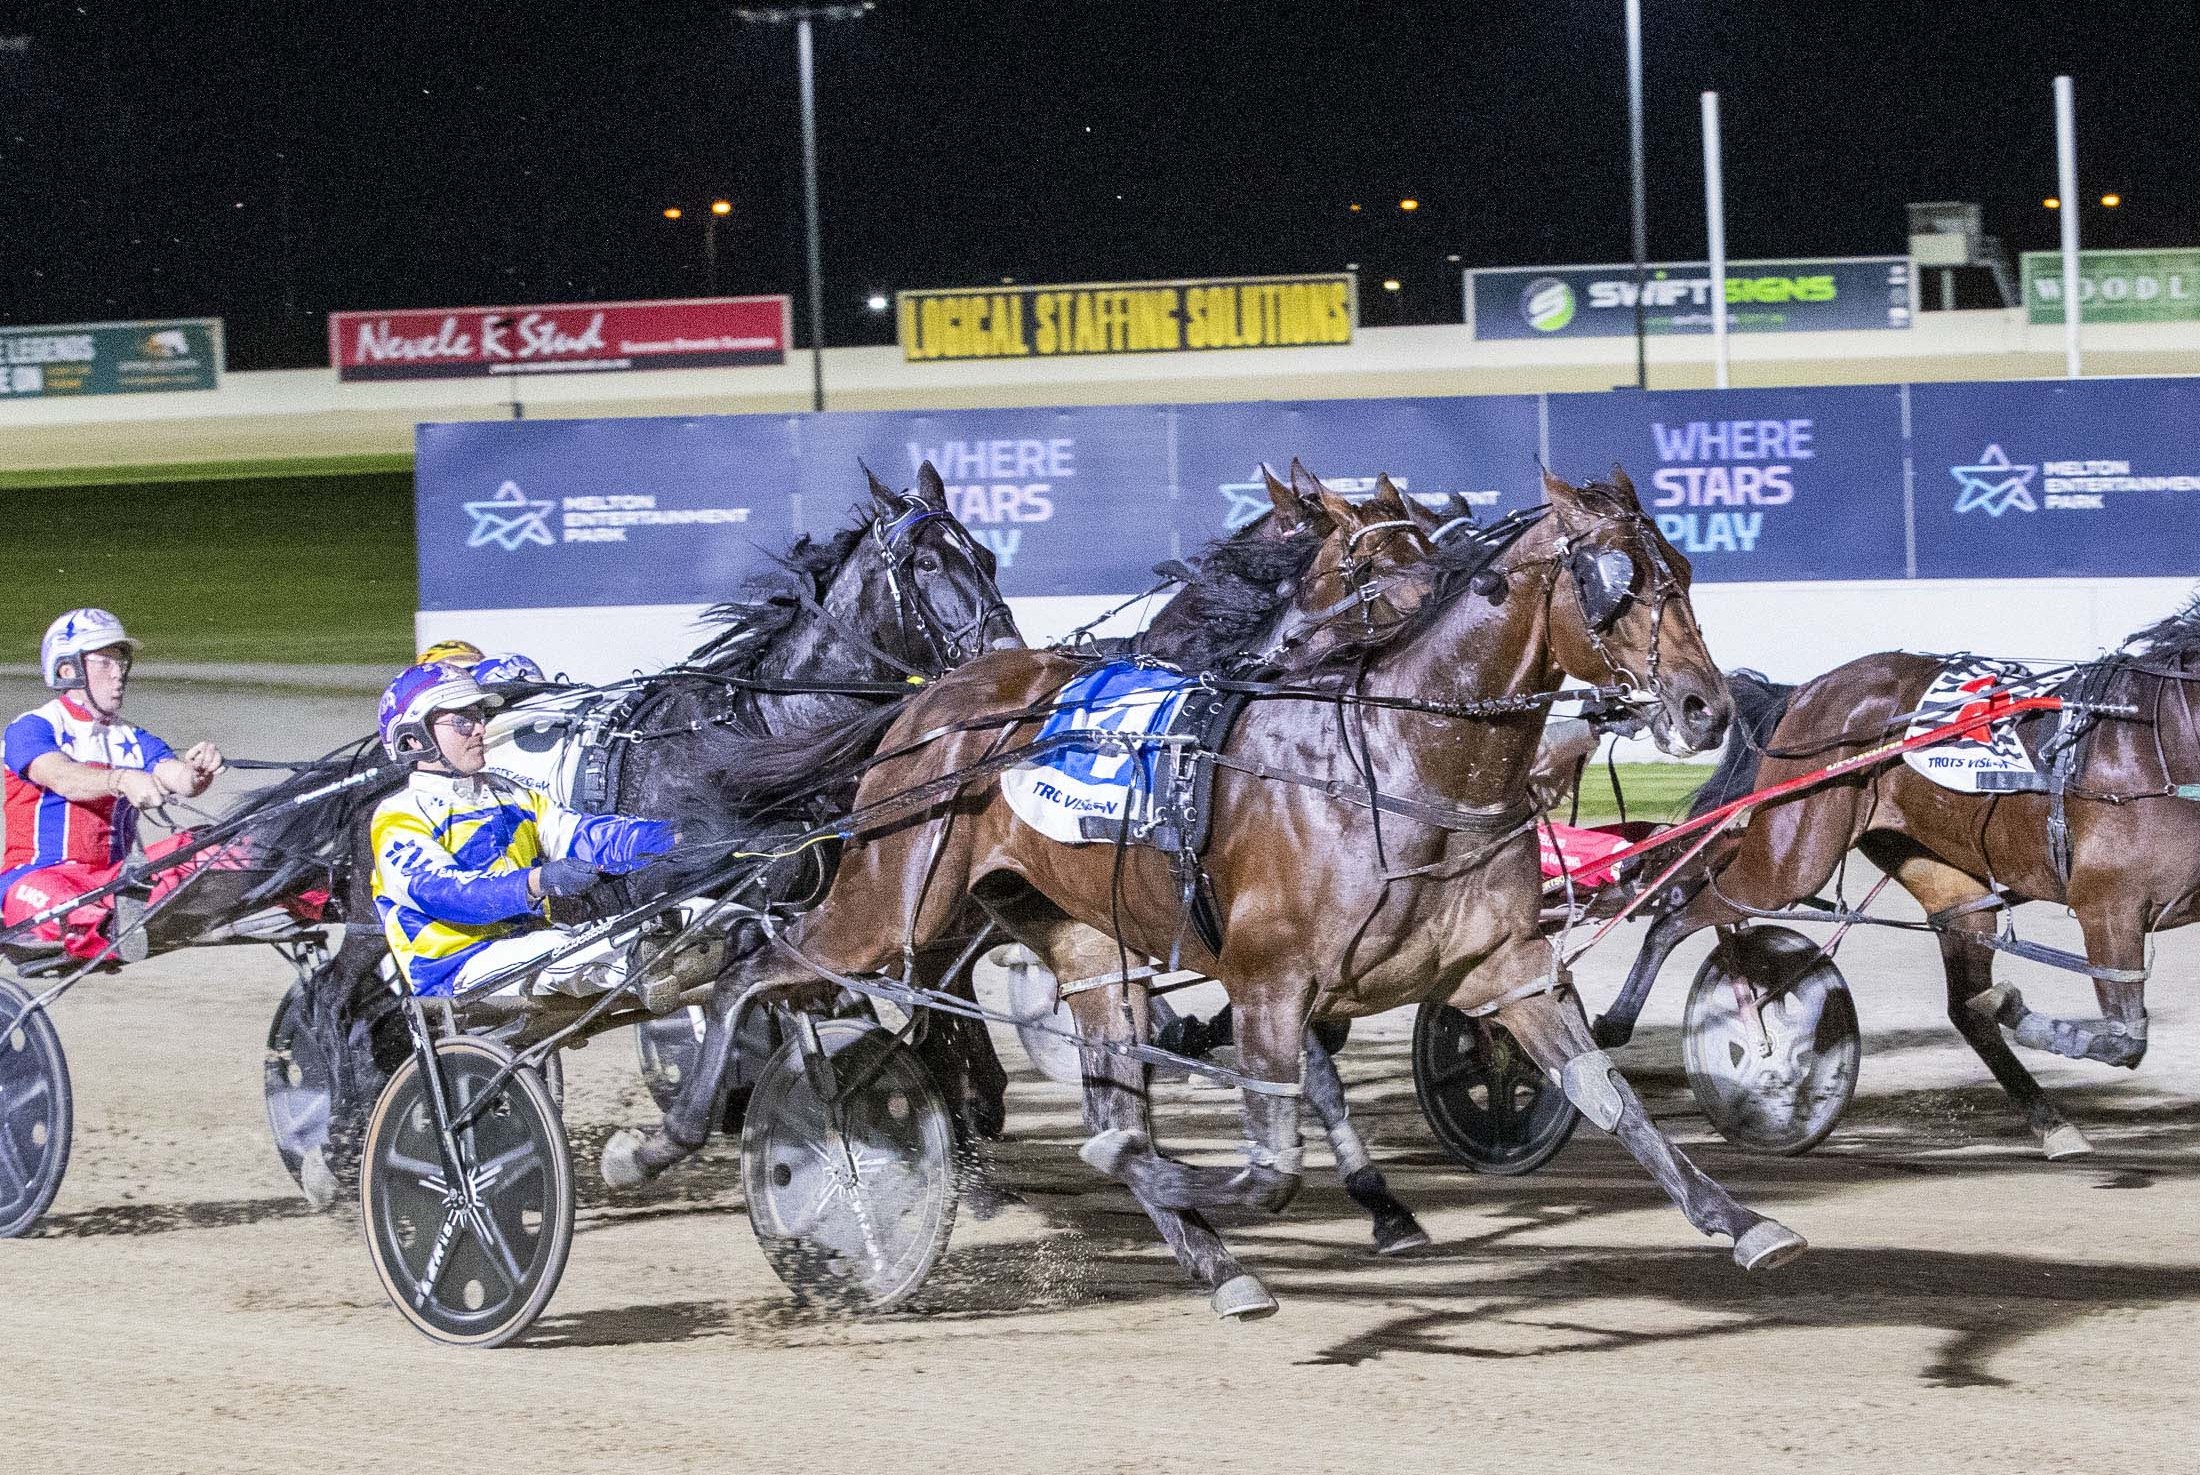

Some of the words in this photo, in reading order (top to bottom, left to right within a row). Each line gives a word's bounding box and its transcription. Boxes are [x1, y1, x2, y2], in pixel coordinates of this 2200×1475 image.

[906, 437, 1074, 479] WHERE
[1651, 418, 1816, 460] WHERE
[945, 482, 1056, 524] TARS
[1652, 465, 1795, 508] STARS
[1654, 511, 1764, 553] PLAY
